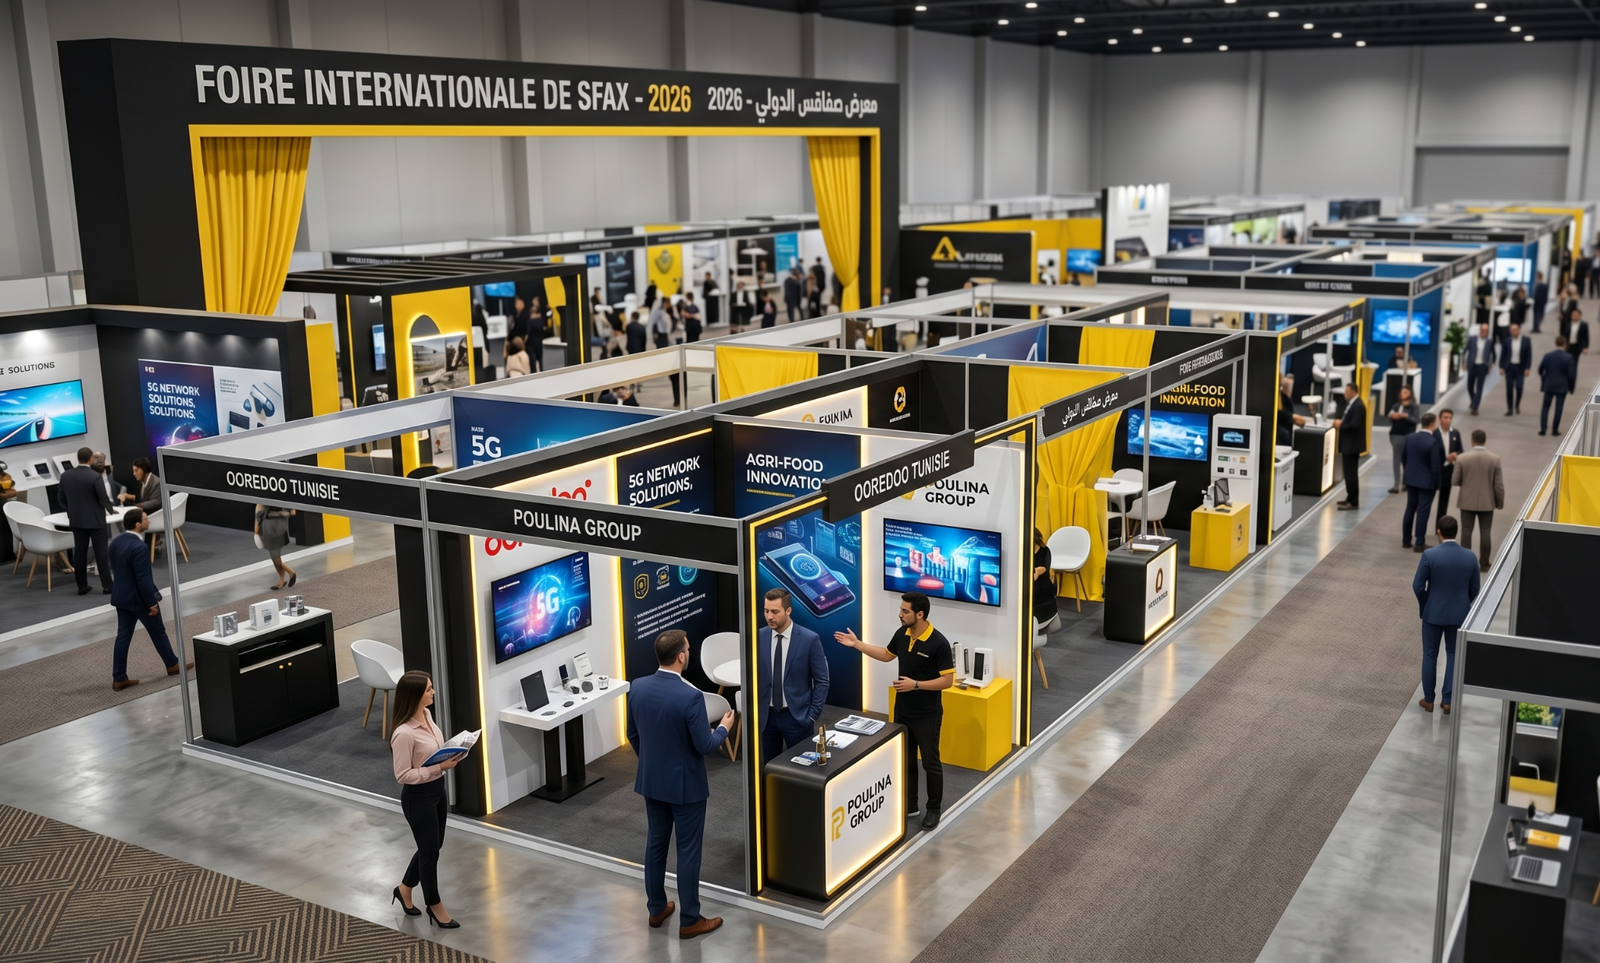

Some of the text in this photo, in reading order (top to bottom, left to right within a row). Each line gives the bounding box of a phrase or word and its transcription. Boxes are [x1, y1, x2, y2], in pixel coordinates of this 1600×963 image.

[195, 64, 296, 105] FOIRE
[304, 69, 537, 110] INTERNATIONALE
[543, 79, 572, 110] DE
[577, 80, 630, 112] SFAX
[648, 83, 692, 113] 2026
[707, 86, 743, 111] 2026
[755, 87, 795, 124] الدولي
[798, 90, 843, 117] صفاقس
[845, 92, 878, 119] معرض
[8, 361, 56, 375] SOLUTIONS
[147, 382, 200, 397] 5G NETWORK
[1160, 394, 1226, 408] INNOVATION
[472, 434, 502, 459] 5G
[628, 455, 700, 489] 5G NETWORK
[746, 453, 824, 473] AGRI-FOOD
[854, 450, 950, 503] OOREDOO TUNISIE
[226, 470, 340, 501] OOREDOO TUNISIE
[746, 469, 826, 490] INNOVATIO
[926, 479, 990, 495] OULINA
[925, 491, 976, 507] GROUP
[513, 508, 642, 542] POULINA GROUP
[536, 586, 560, 620] 5G
[847, 773, 893, 815] POULINA
[850, 795, 885, 829] GROUP
